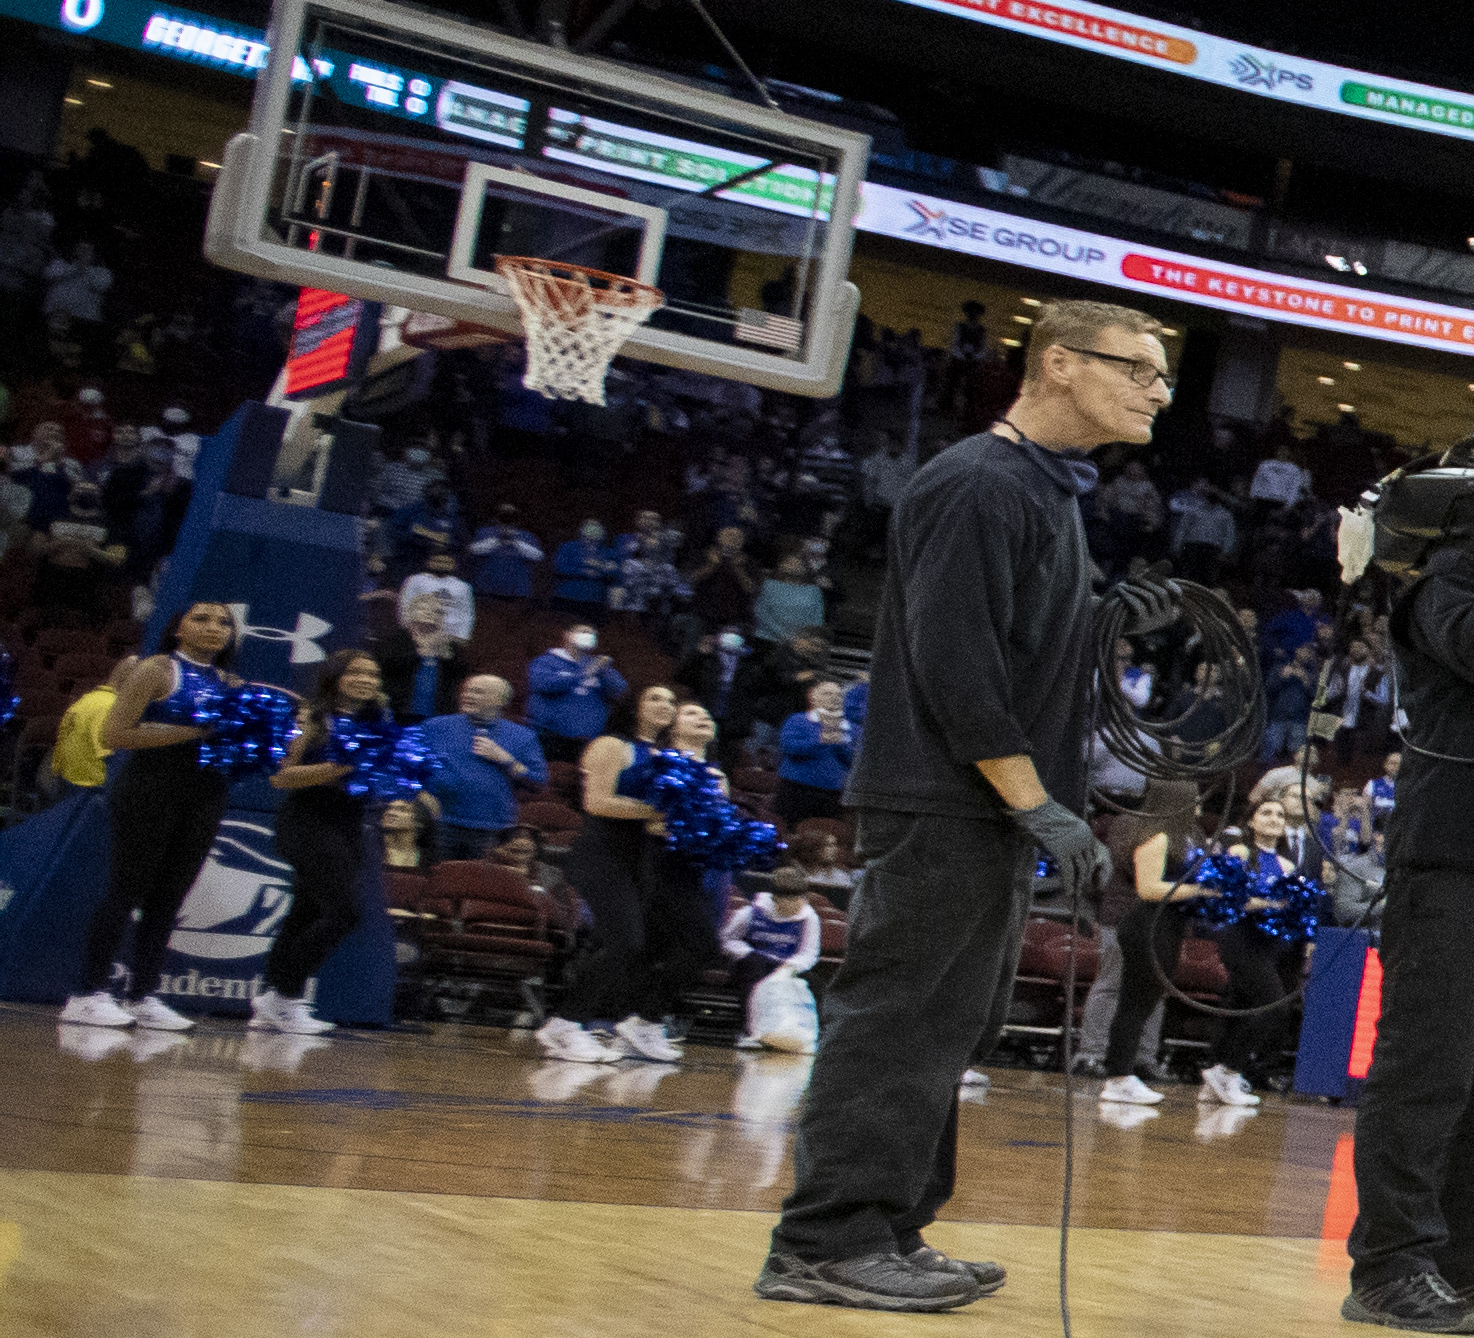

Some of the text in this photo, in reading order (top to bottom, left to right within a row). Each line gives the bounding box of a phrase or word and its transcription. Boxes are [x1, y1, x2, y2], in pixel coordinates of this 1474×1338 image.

[1150, 264, 1197, 288] THE
[1207, 275, 1336, 315] KEYSTONE
[1346, 303, 1376, 322] TO
[1384, 310, 1454, 337] PRINT
